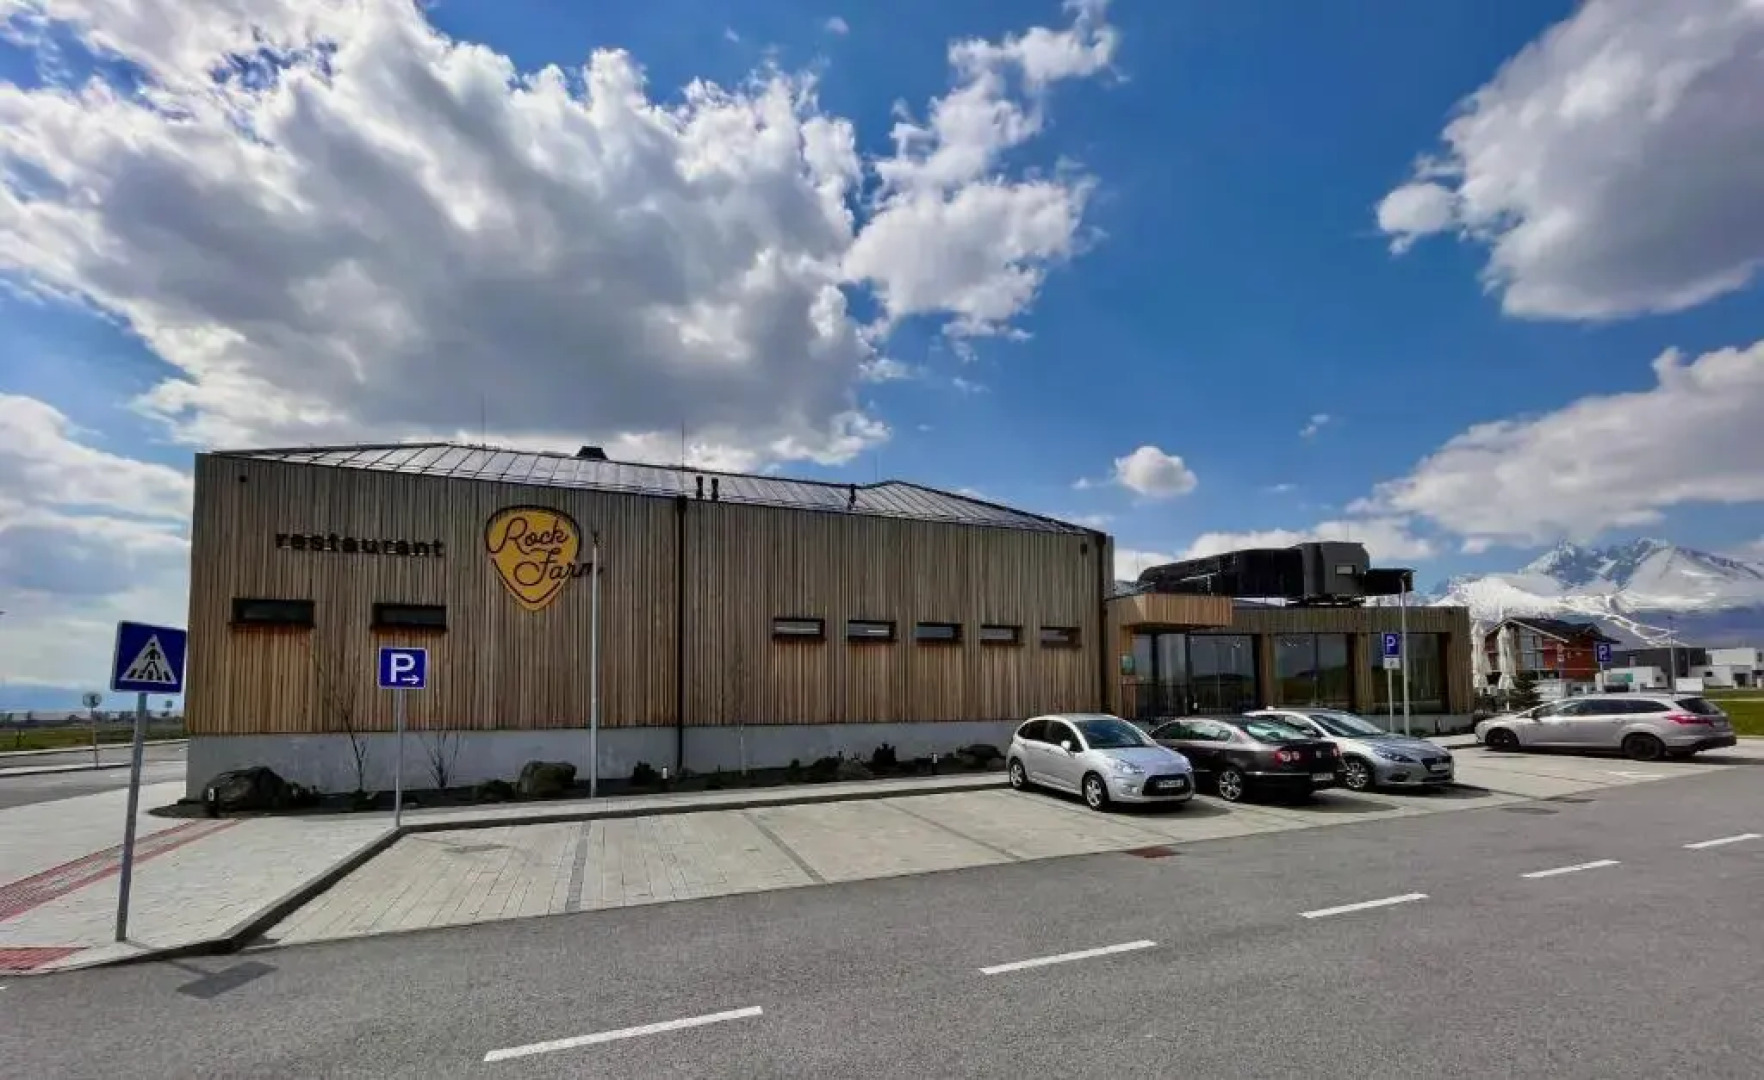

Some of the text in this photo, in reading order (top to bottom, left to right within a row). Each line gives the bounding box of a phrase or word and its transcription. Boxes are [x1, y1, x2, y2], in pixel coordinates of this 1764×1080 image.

[275, 533, 444, 557] restaurant
[486, 516, 569, 554] Rock
[1386, 635, 1396, 653] P
[1598, 645, 1608, 660] P
[391, 653, 415, 682] P
